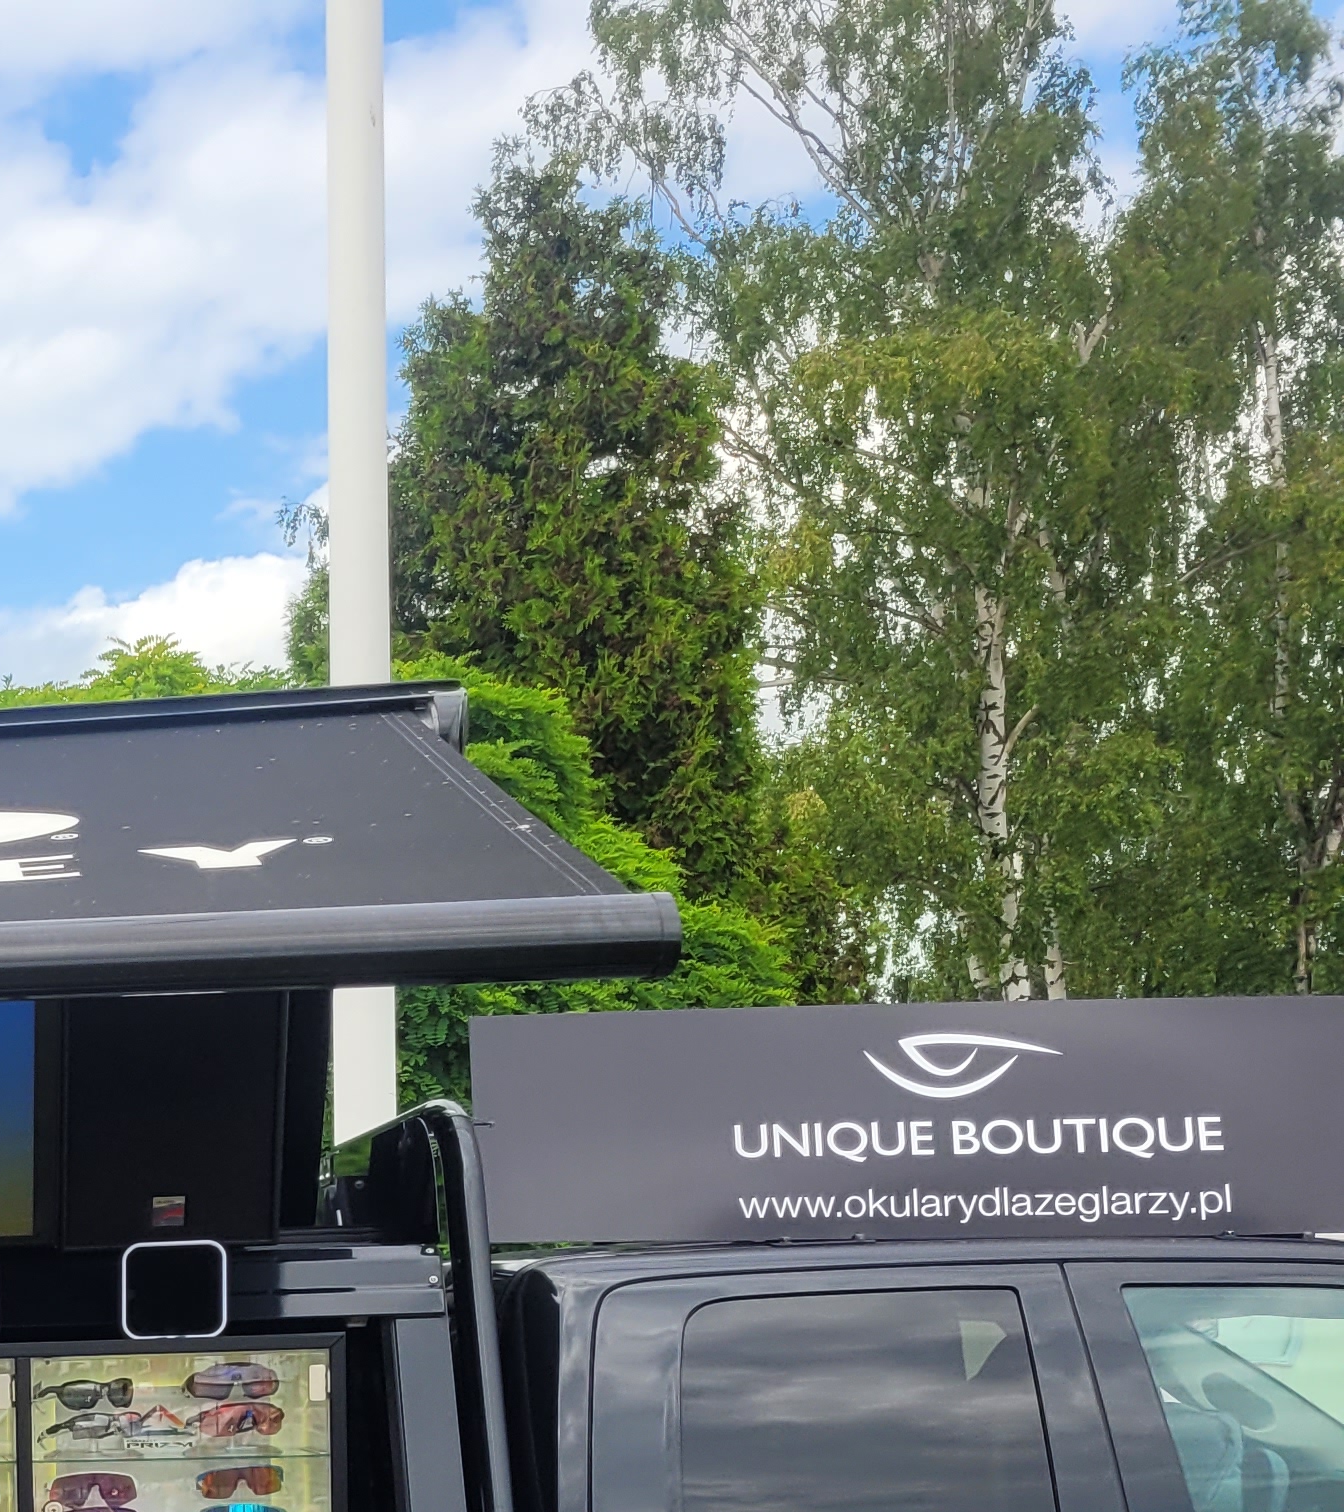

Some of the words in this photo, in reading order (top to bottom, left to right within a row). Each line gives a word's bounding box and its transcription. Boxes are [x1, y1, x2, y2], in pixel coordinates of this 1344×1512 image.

[732, 1119, 936, 1163] UNIQUE
[951, 1115, 1226, 1160] BOUTIQUE
[738, 1183, 1234, 1224] www.okularydlazeglarzy.pl
